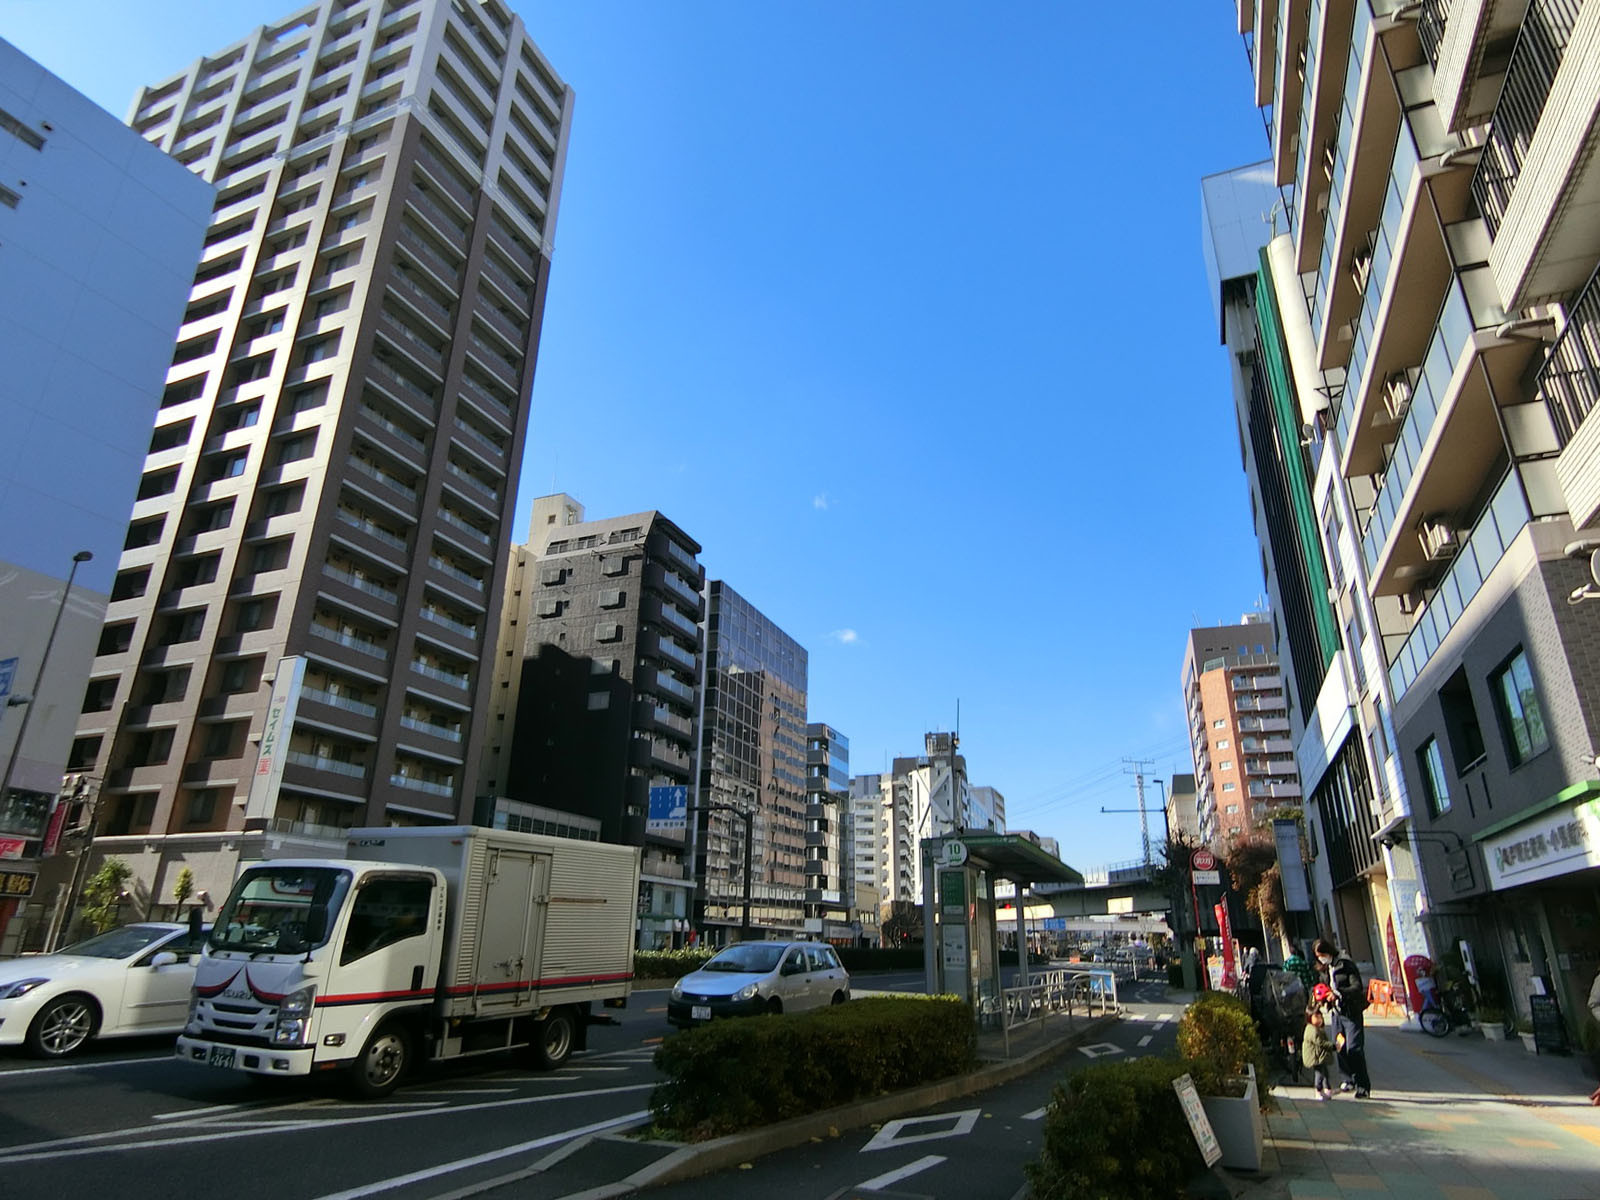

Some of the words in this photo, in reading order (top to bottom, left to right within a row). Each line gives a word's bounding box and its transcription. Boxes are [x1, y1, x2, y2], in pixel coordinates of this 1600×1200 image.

[262, 708, 281, 755] セイムス
[948, 843, 961, 855] 10
[223, 989, 253, 1001] ISUZU
